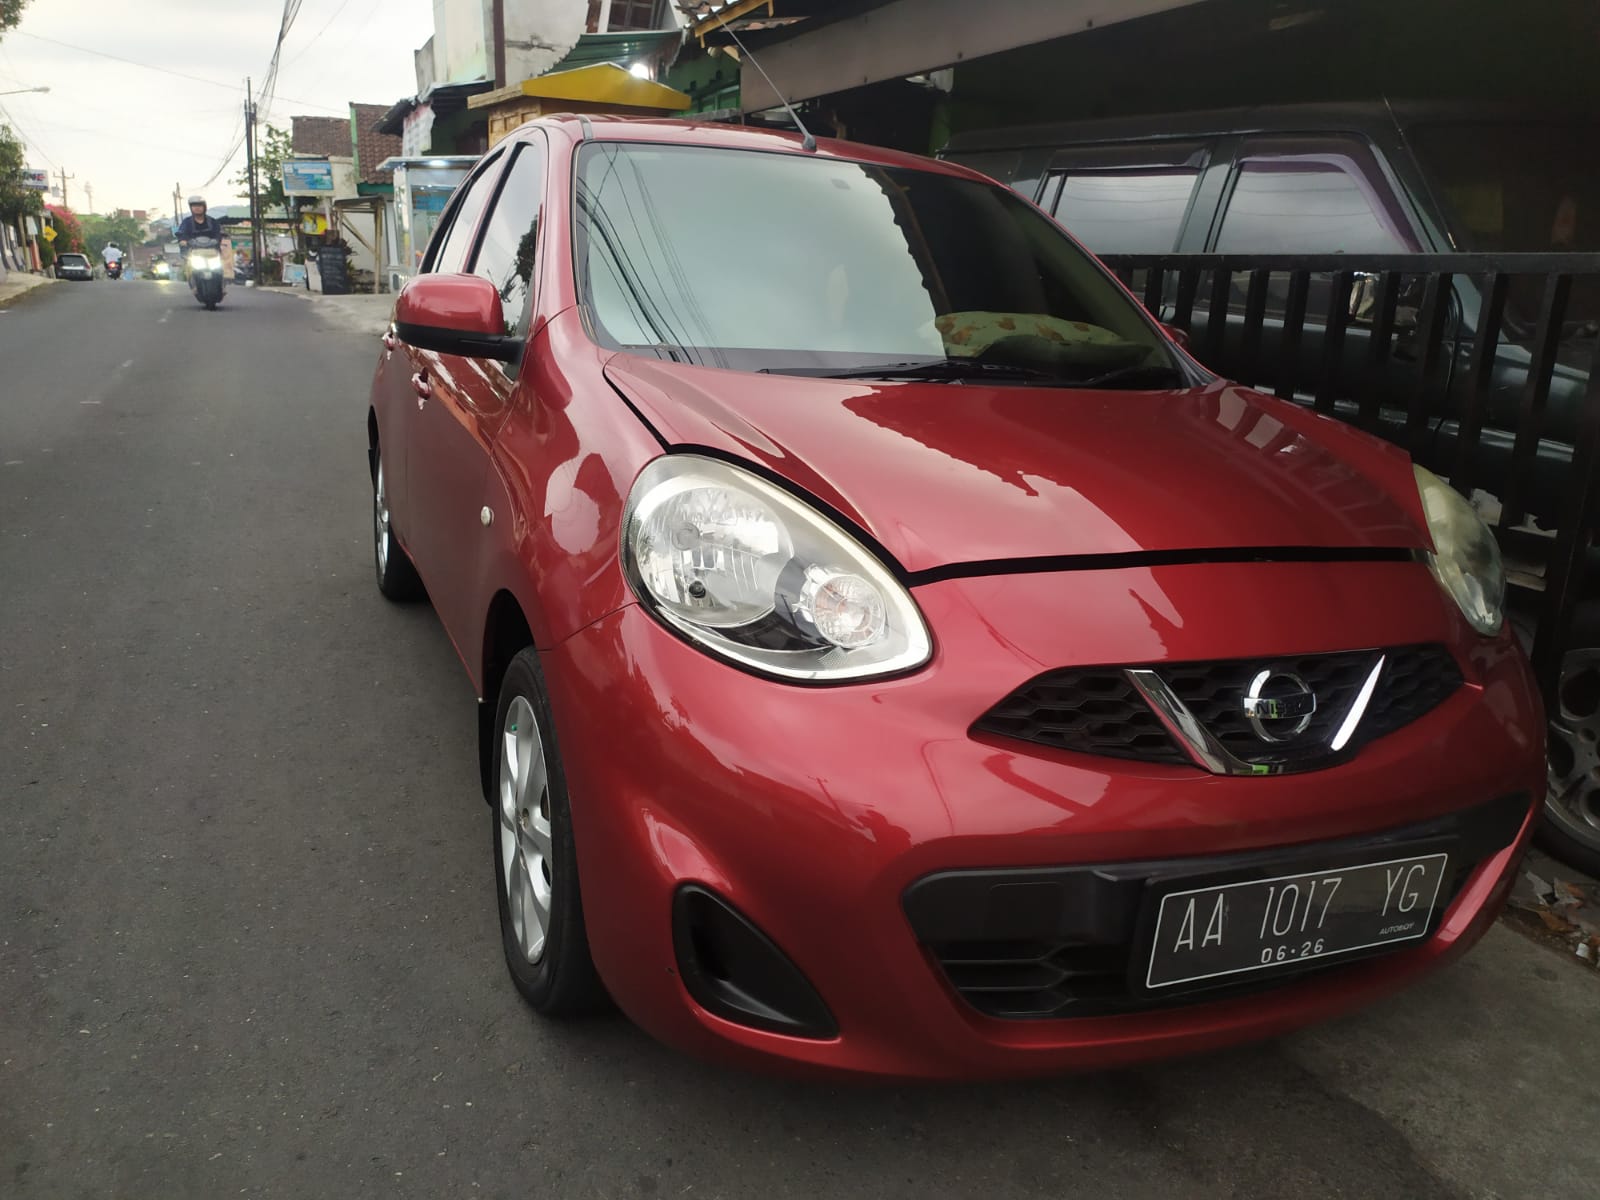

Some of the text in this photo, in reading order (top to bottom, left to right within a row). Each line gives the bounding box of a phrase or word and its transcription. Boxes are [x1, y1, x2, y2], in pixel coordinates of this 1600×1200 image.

[1173, 864, 1426, 953] AA 1017 YG
